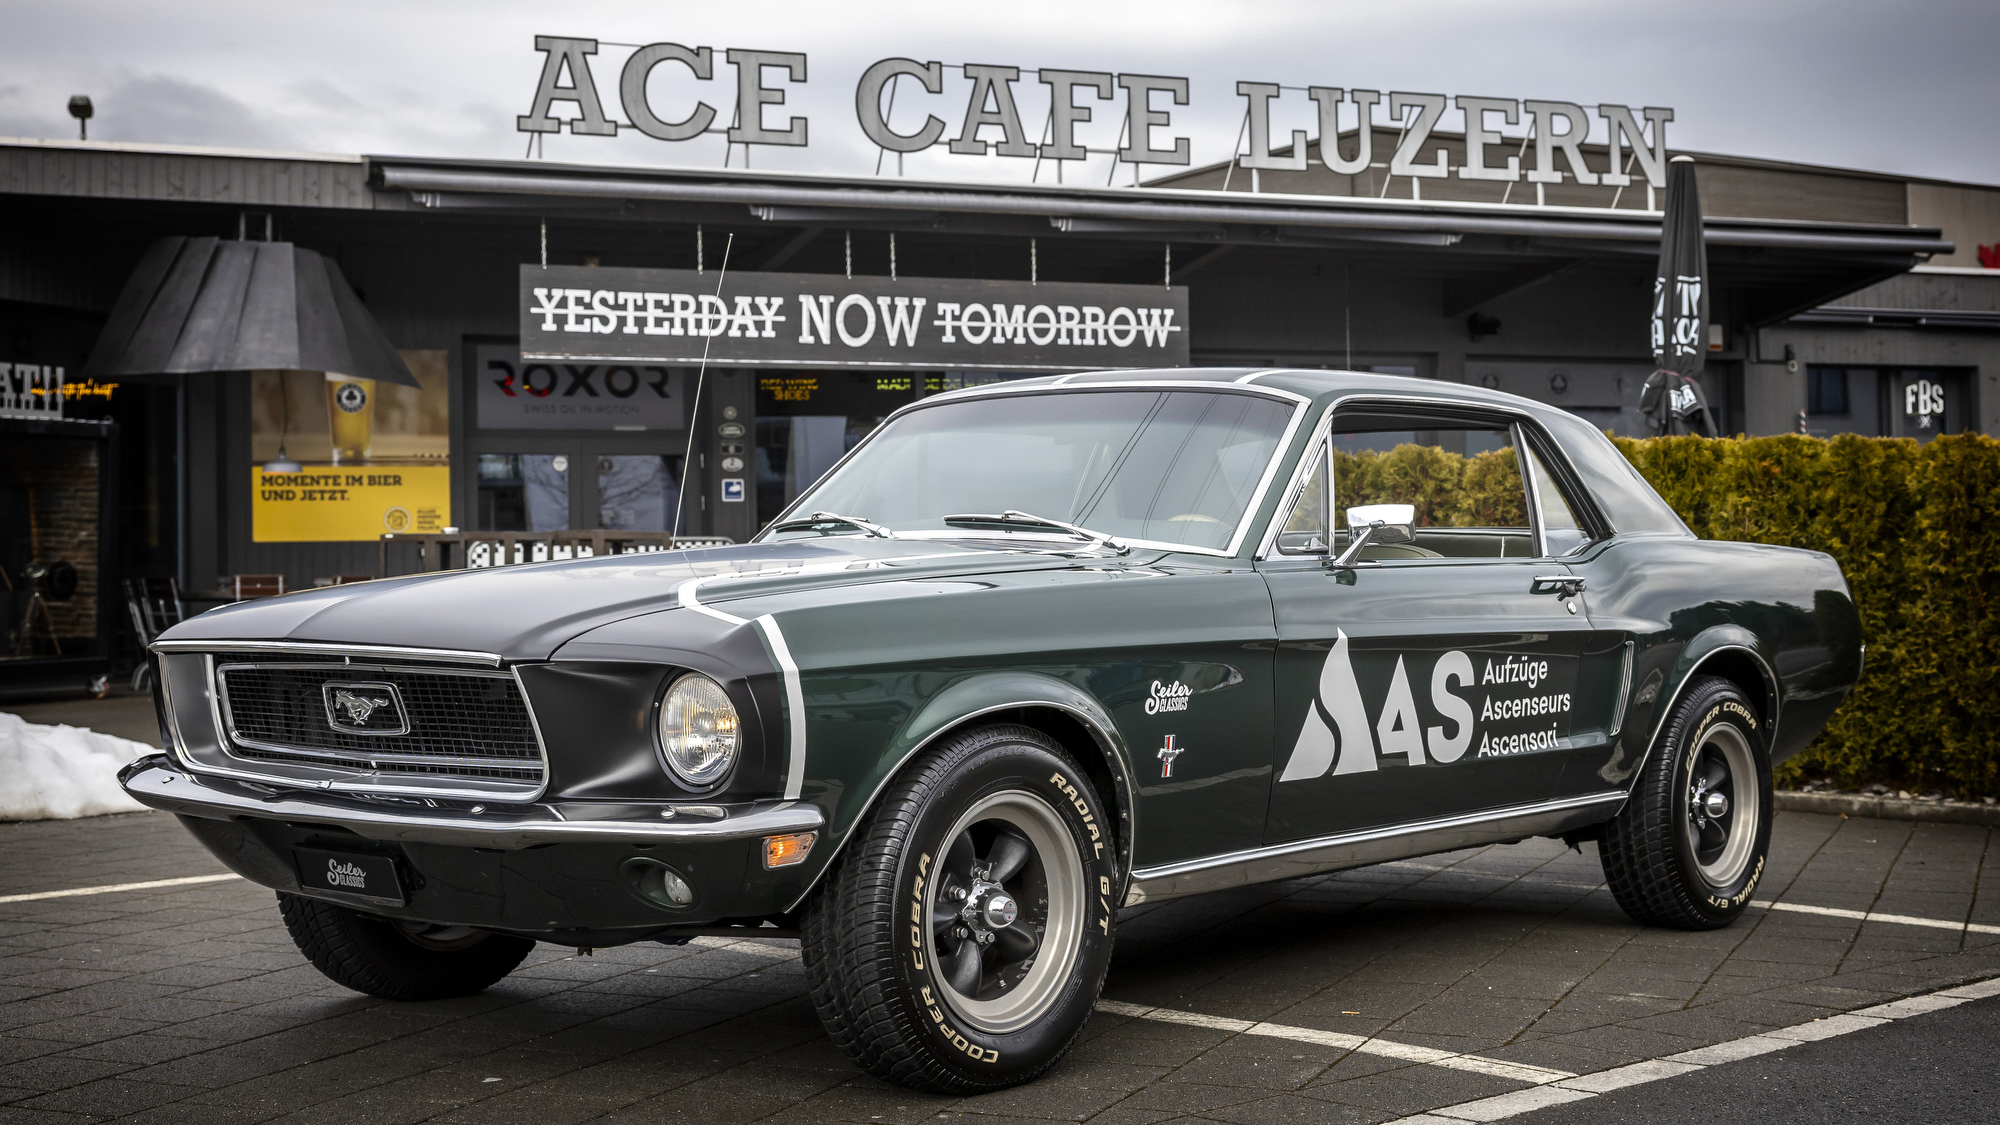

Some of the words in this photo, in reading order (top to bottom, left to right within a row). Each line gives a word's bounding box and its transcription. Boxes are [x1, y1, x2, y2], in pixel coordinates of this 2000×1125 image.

[517, 35, 808, 147] ACE
[855, 57, 1190, 166] CAFE
[1236, 81, 1675, 189] LUZERN
[530, 287, 786, 339] YESTERDAY
[798, 294, 927, 348] NOW
[933, 302, 1182, 349] TOMORROW
[487, 360, 671, 399] ROXOR
[1905, 380, 1944, 415] FBS
[523, 404, 557, 415] SWISS
[559, 404, 578, 415] OIL
[580, 405, 593, 415] IN
[596, 405, 641, 416] MOTION
[260, 474, 342, 487] MOMENTE
[345, 474, 363, 487] IM
[367, 474, 403, 487] BIER
[260, 489, 297, 502] UND
[299, 489, 350, 502] JETZT.
[1482, 655, 1548, 689] Aufzüge
[1144, 680, 1193, 716] Seiler
[1159, 696, 1189, 713] CLASSICS
[1480, 692, 1572, 722] Ascenseurs
[1477, 721, 1561, 758] Ascensori
[1685, 704, 1720, 772] COOPER
[1722, 701, 1757, 730] COBRA
[326, 858, 367, 886] Seiler
[1048, 771, 1101, 861] RADIAL
[1098, 874, 1111, 937] G/T
[339, 874, 366, 888] CLASSICS
[1732, 854, 1765, 906] RADIAL
[911, 852, 931, 971] COBRA
[921, 984, 999, 1064] COOPER
